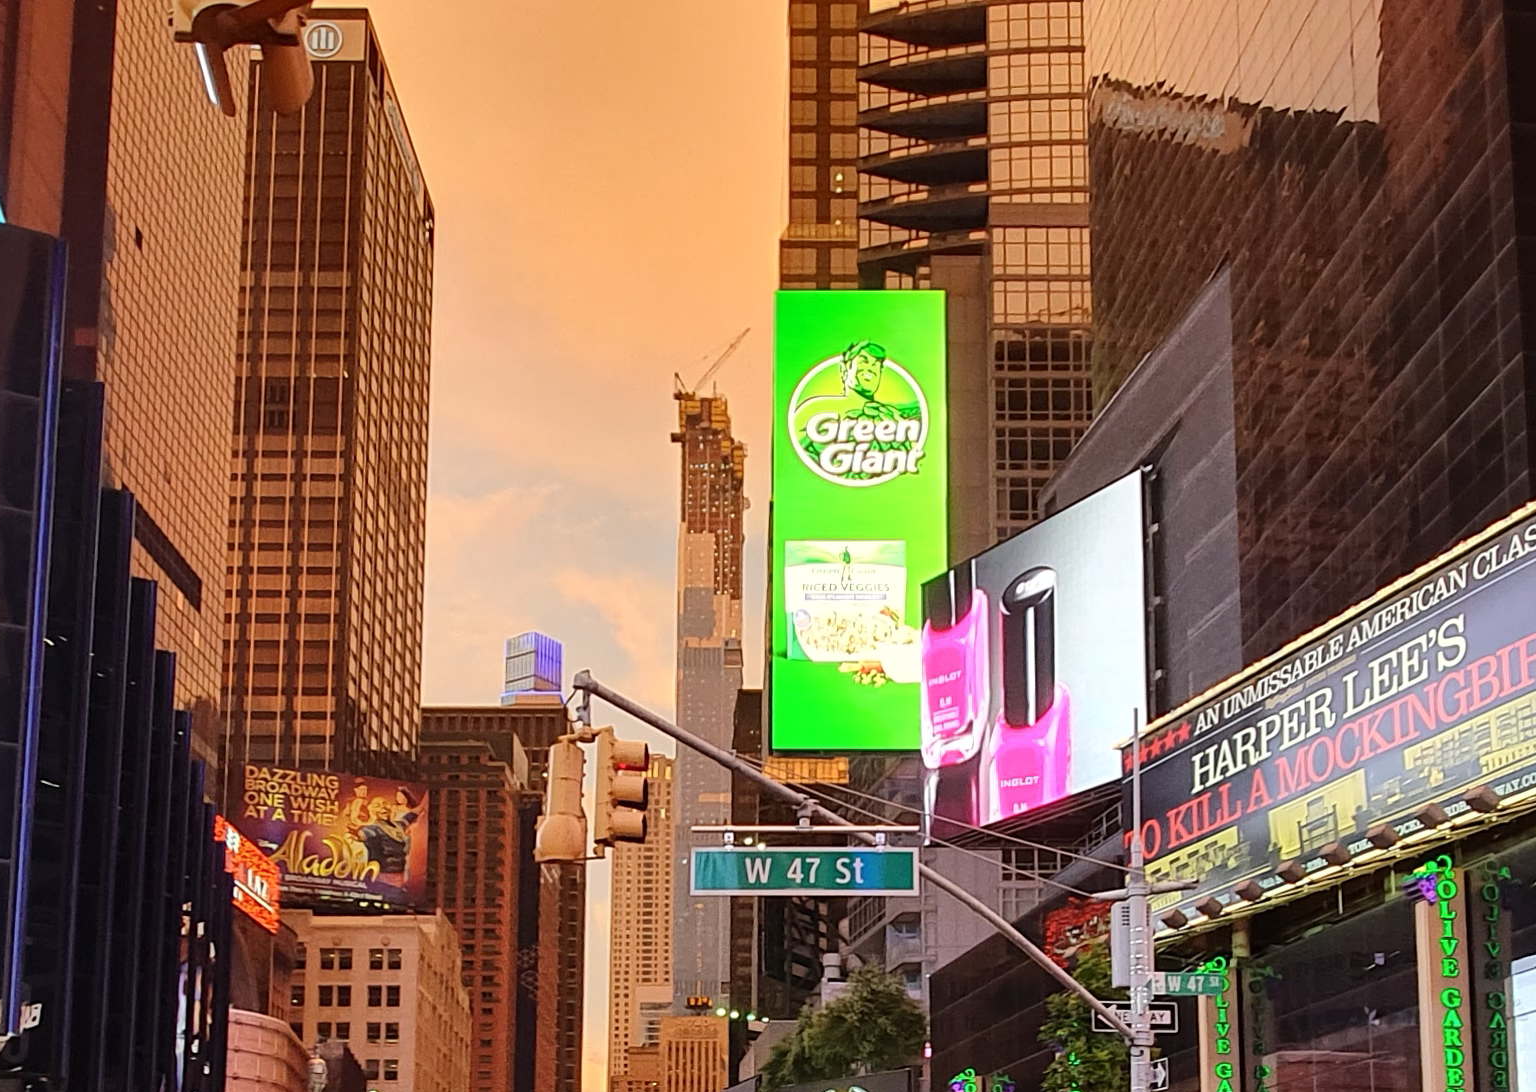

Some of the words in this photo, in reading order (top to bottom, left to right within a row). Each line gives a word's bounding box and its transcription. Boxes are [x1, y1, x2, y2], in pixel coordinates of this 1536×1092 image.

[806, 413, 921, 444] Green
[819, 441, 925, 477] Giant
[841, 583, 890, 592] VEGGIES
[1193, 703, 1223, 736] AN
[1223, 637, 1345, 718] UNMISSABLE
[1345, 561, 1471, 653] AMERICAN
[1190, 686, 1337, 795] HARPER
[1343, 614, 1468, 720] LEE'S
[244, 765, 339, 789] DAZZLING
[244, 779, 339, 799] BROADWAY
[1000, 775, 1040, 788] INGLOT
[244, 791, 285, 808] ONE
[292, 796, 339, 815] WISH
[244, 805, 268, 819] AT
[271, 807, 287, 822] A
[291, 809, 336, 825] TIME
[1166, 782, 1243, 849] KILL
[1247, 768, 1276, 814] A
[268, 829, 381, 883] Aladdin
[745, 857, 772, 884] W
[786, 857, 821, 884] 47
[835, 856, 865, 885] St
[1435, 879, 1460, 978] OLIVE
[1167, 976, 1183, 991] W
[1187, 976, 1204, 992] 47
